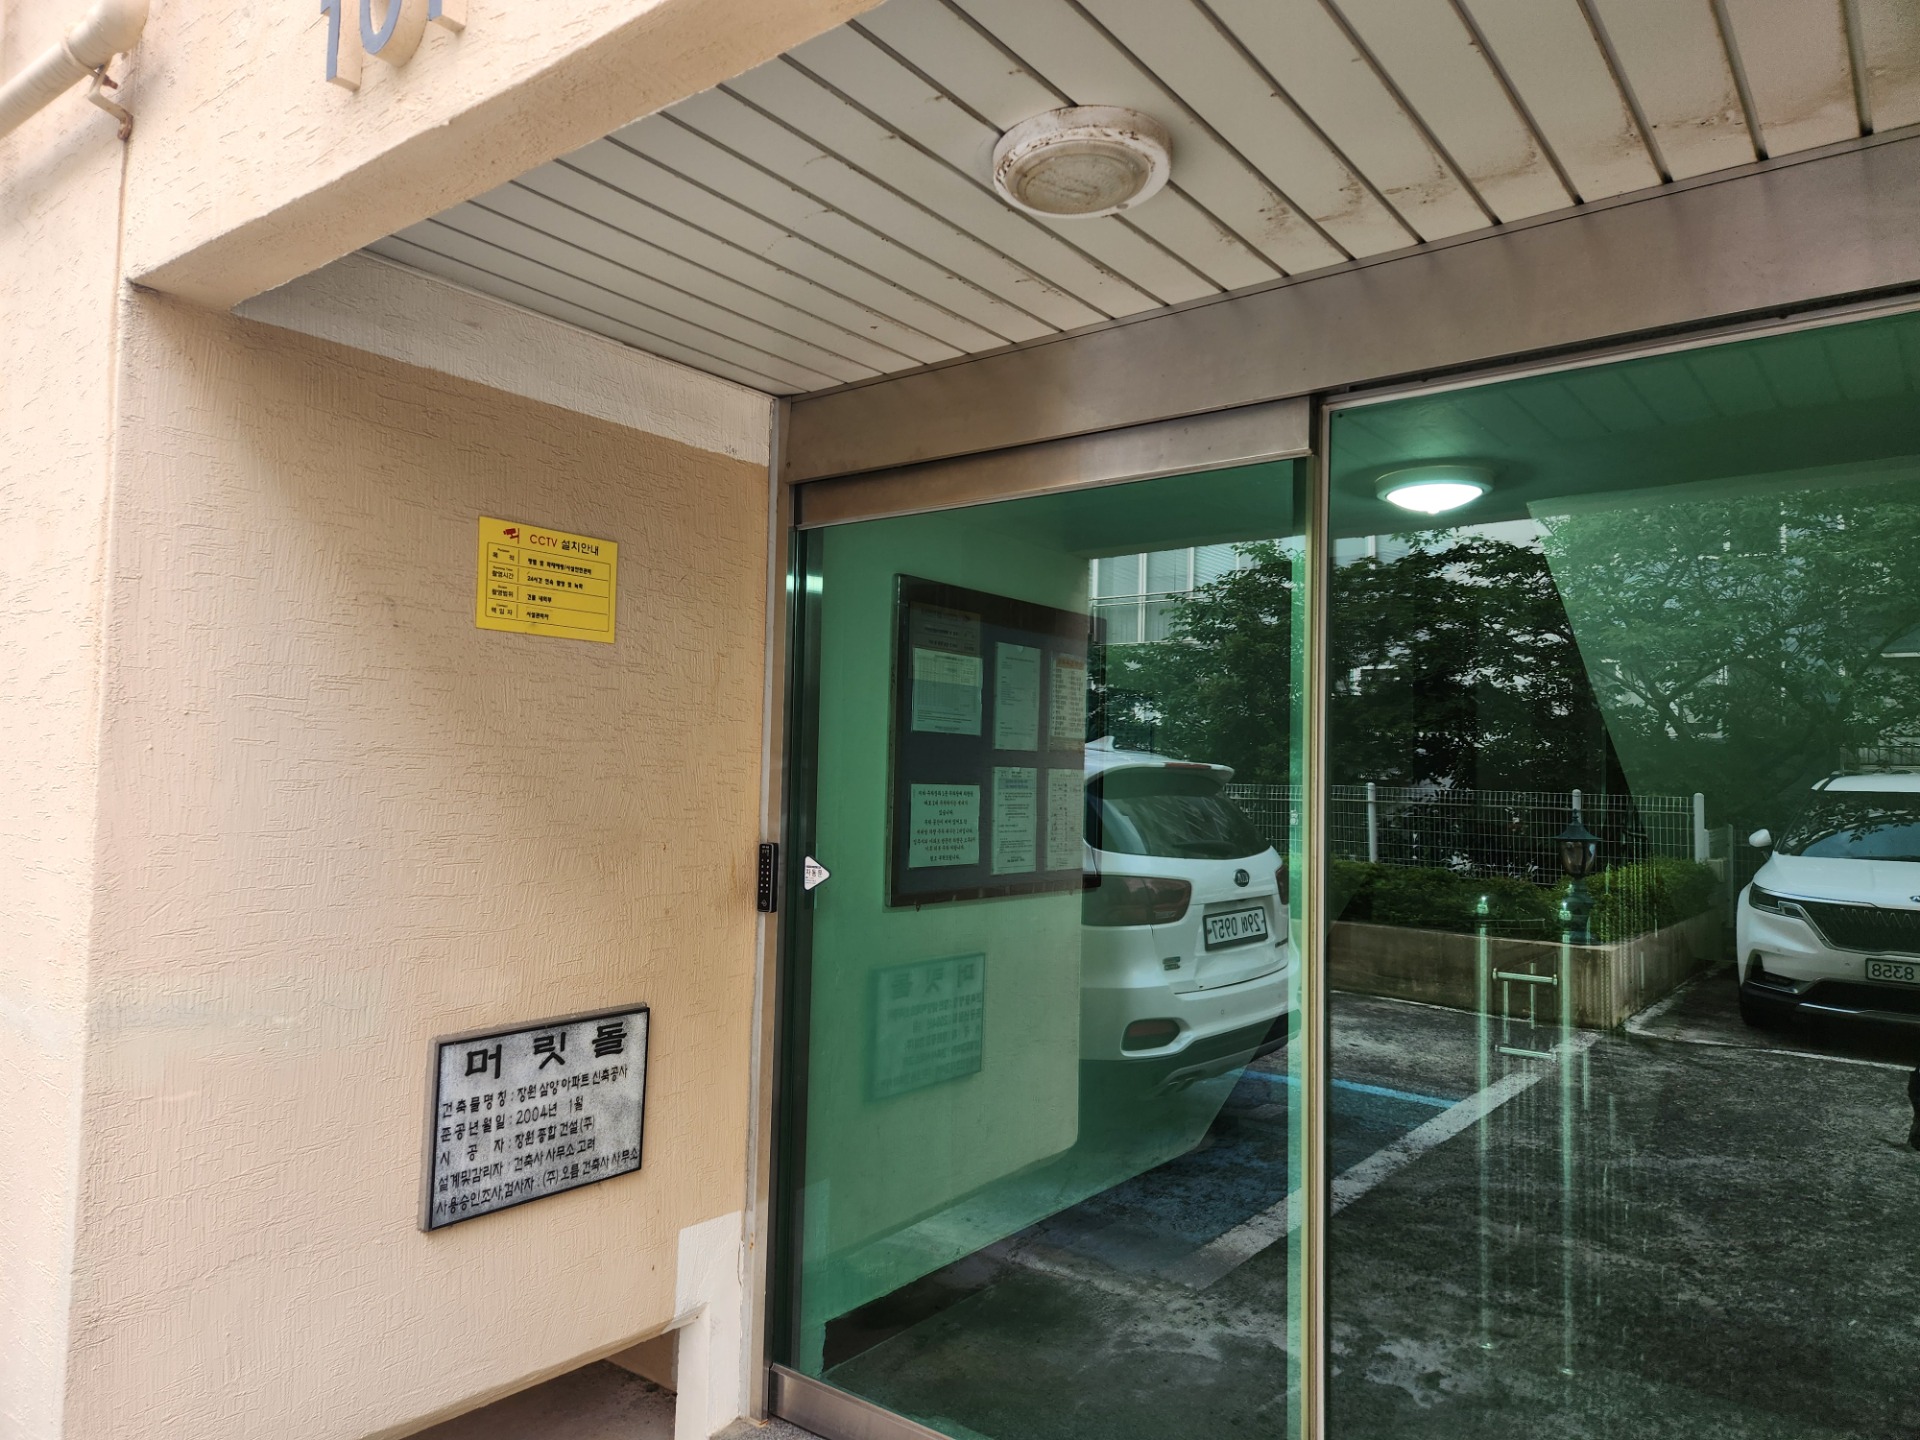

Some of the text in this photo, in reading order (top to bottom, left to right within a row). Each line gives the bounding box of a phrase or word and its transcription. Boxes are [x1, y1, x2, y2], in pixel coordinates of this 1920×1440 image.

[530, 534, 599, 555] CCTV 설치안내
[527, 575, 542, 584] 24시간
[516, 1084, 537, 1103] 장원
[539, 1080, 561, 1099] 삼양
[561, 1073, 590, 1094] 아파트
[592, 1064, 628, 1086] 신축공사
[515, 1104, 558, 1125] 2004년
[568, 1095, 585, 1115] 1월
[514, 1130, 535, 1150] 장원
[537, 1125, 556, 1145] 종합
[513, 1153, 544, 1173] 건축사
[545, 1144, 576, 1165] 사무소
[577, 1137, 596, 1153] 고려
[561, 1162, 580, 1181] 오름
[582, 1153, 609, 1176] 건축사
[611, 1146, 640, 1167] 사무소
